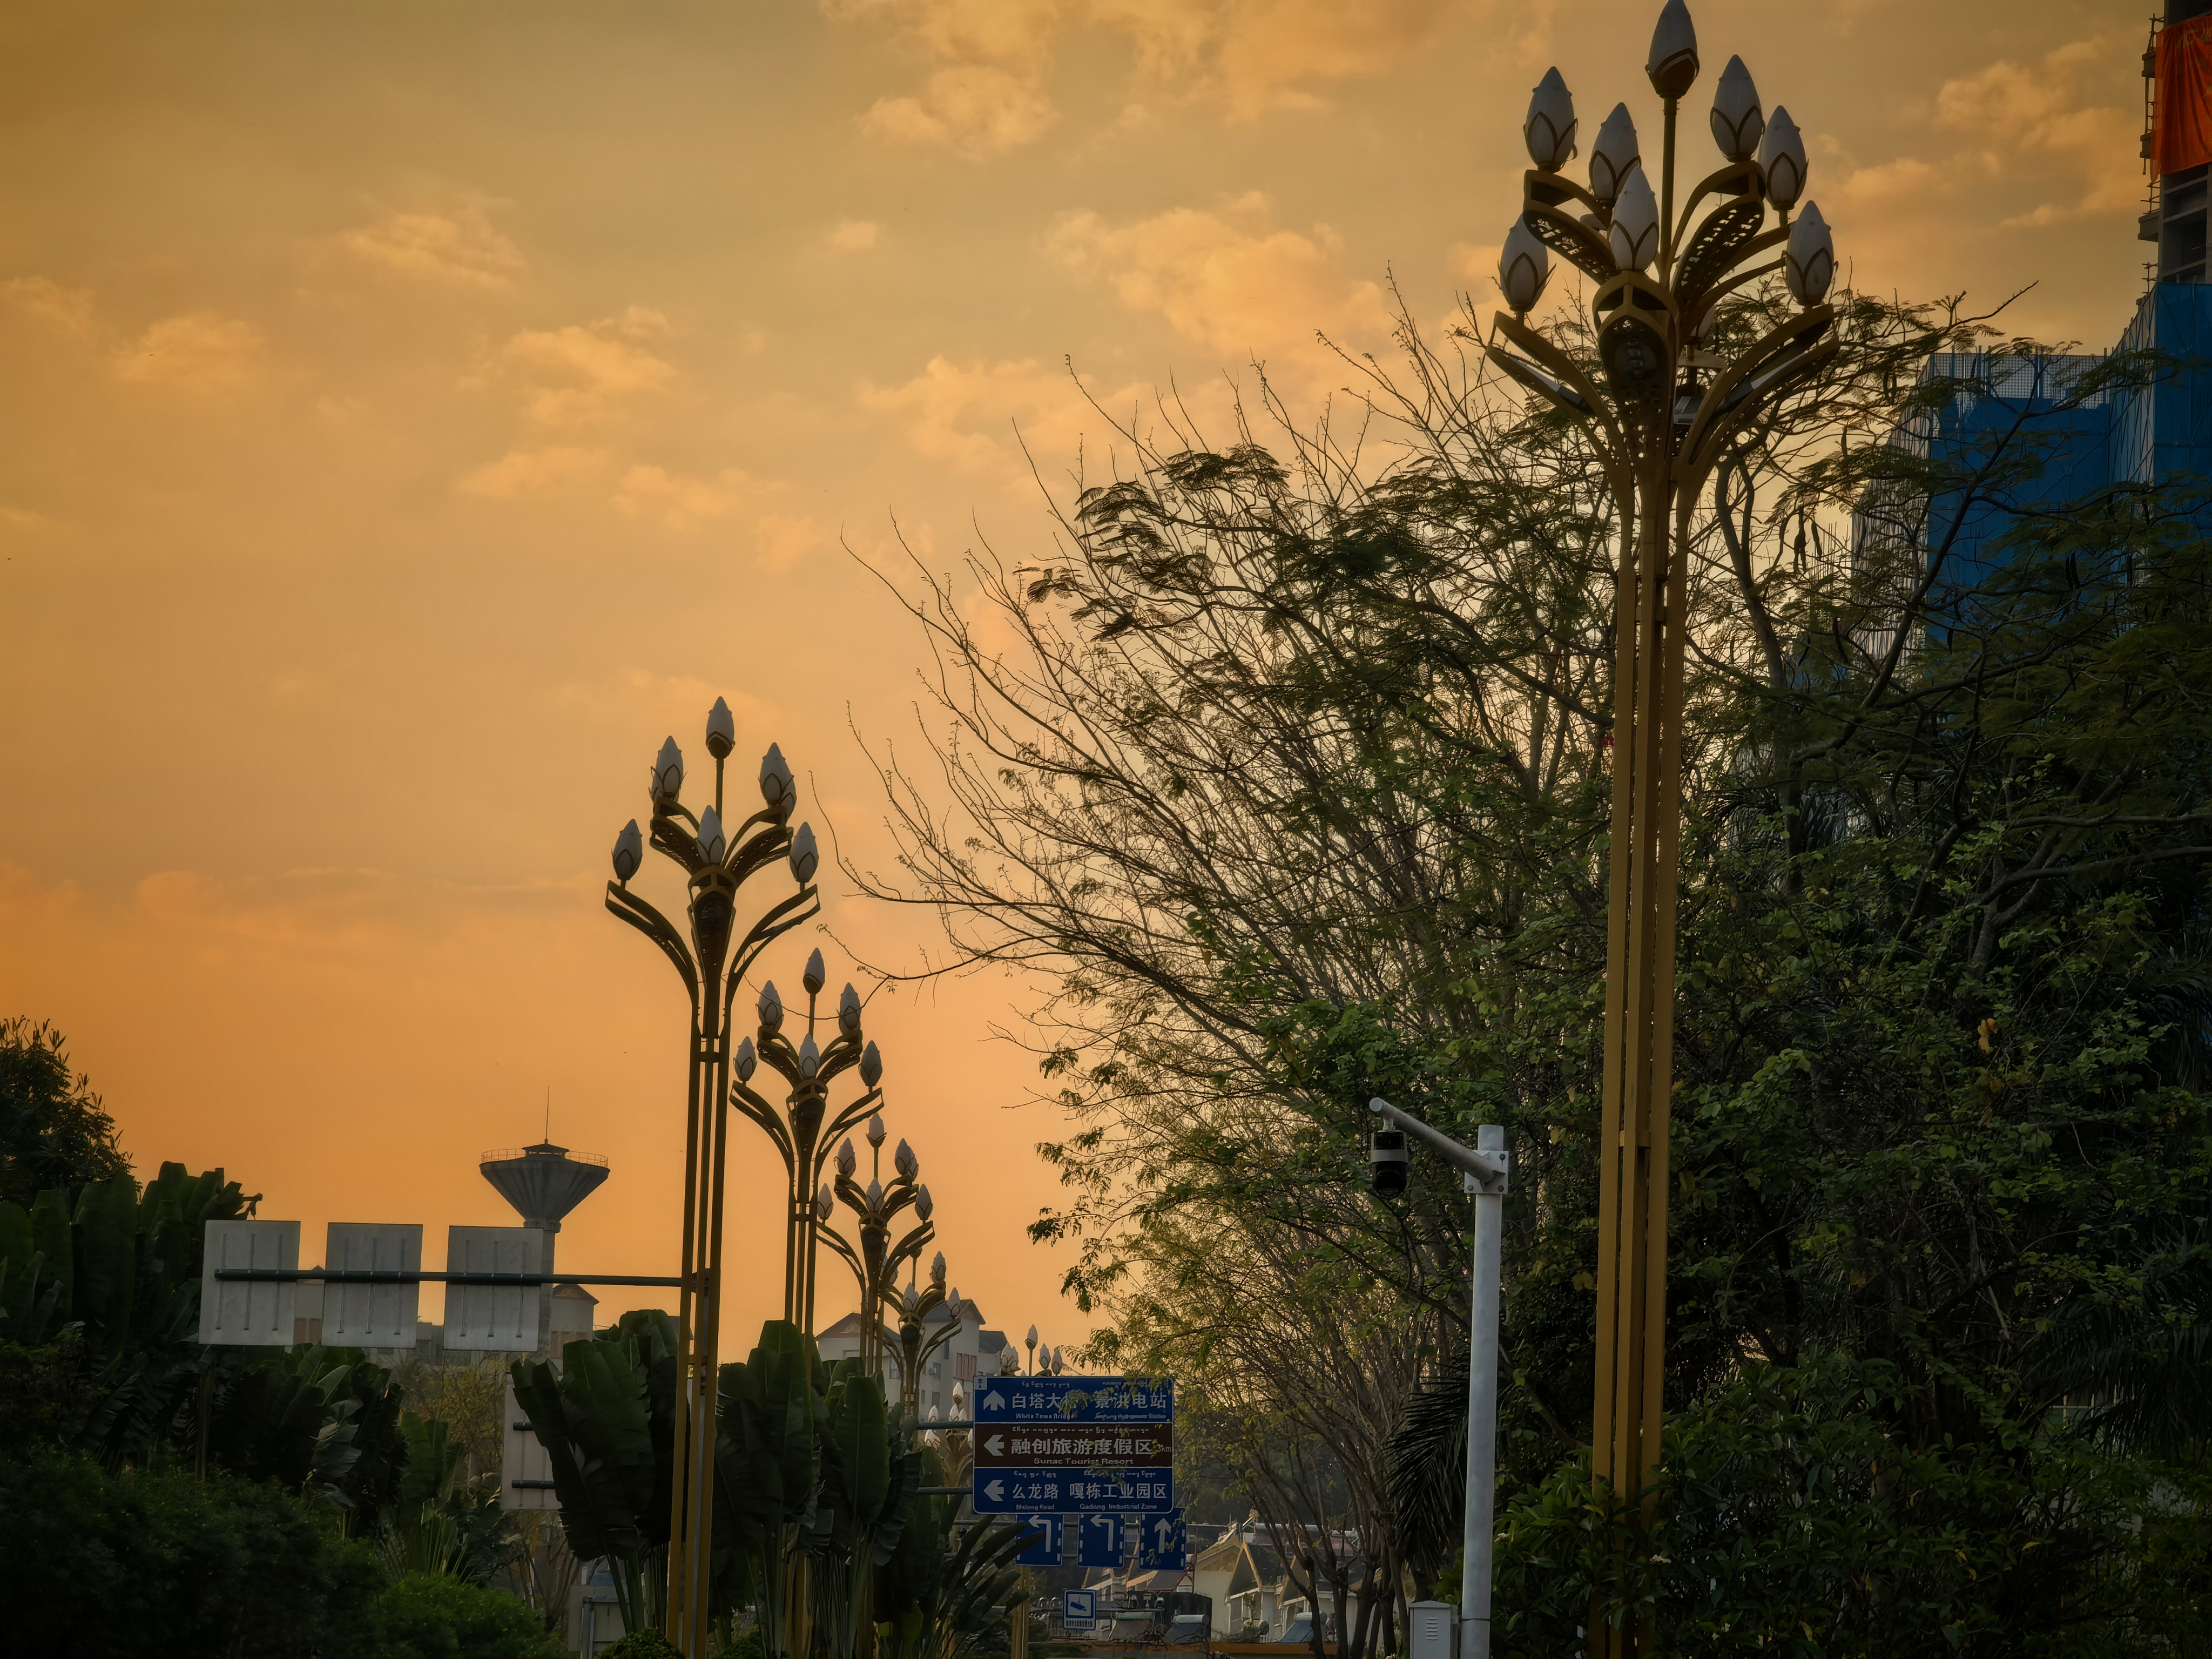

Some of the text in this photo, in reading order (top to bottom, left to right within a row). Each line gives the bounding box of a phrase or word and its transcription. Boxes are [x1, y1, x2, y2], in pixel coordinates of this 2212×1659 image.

[1011, 1392, 1079, 1410] 白塔大
[1011, 1438, 1153, 1455] 融创旅游度假区
[1012, 1483, 1059, 1499] 么龙路
[1070, 1482, 1167, 1499] 嘎栋工业园区
